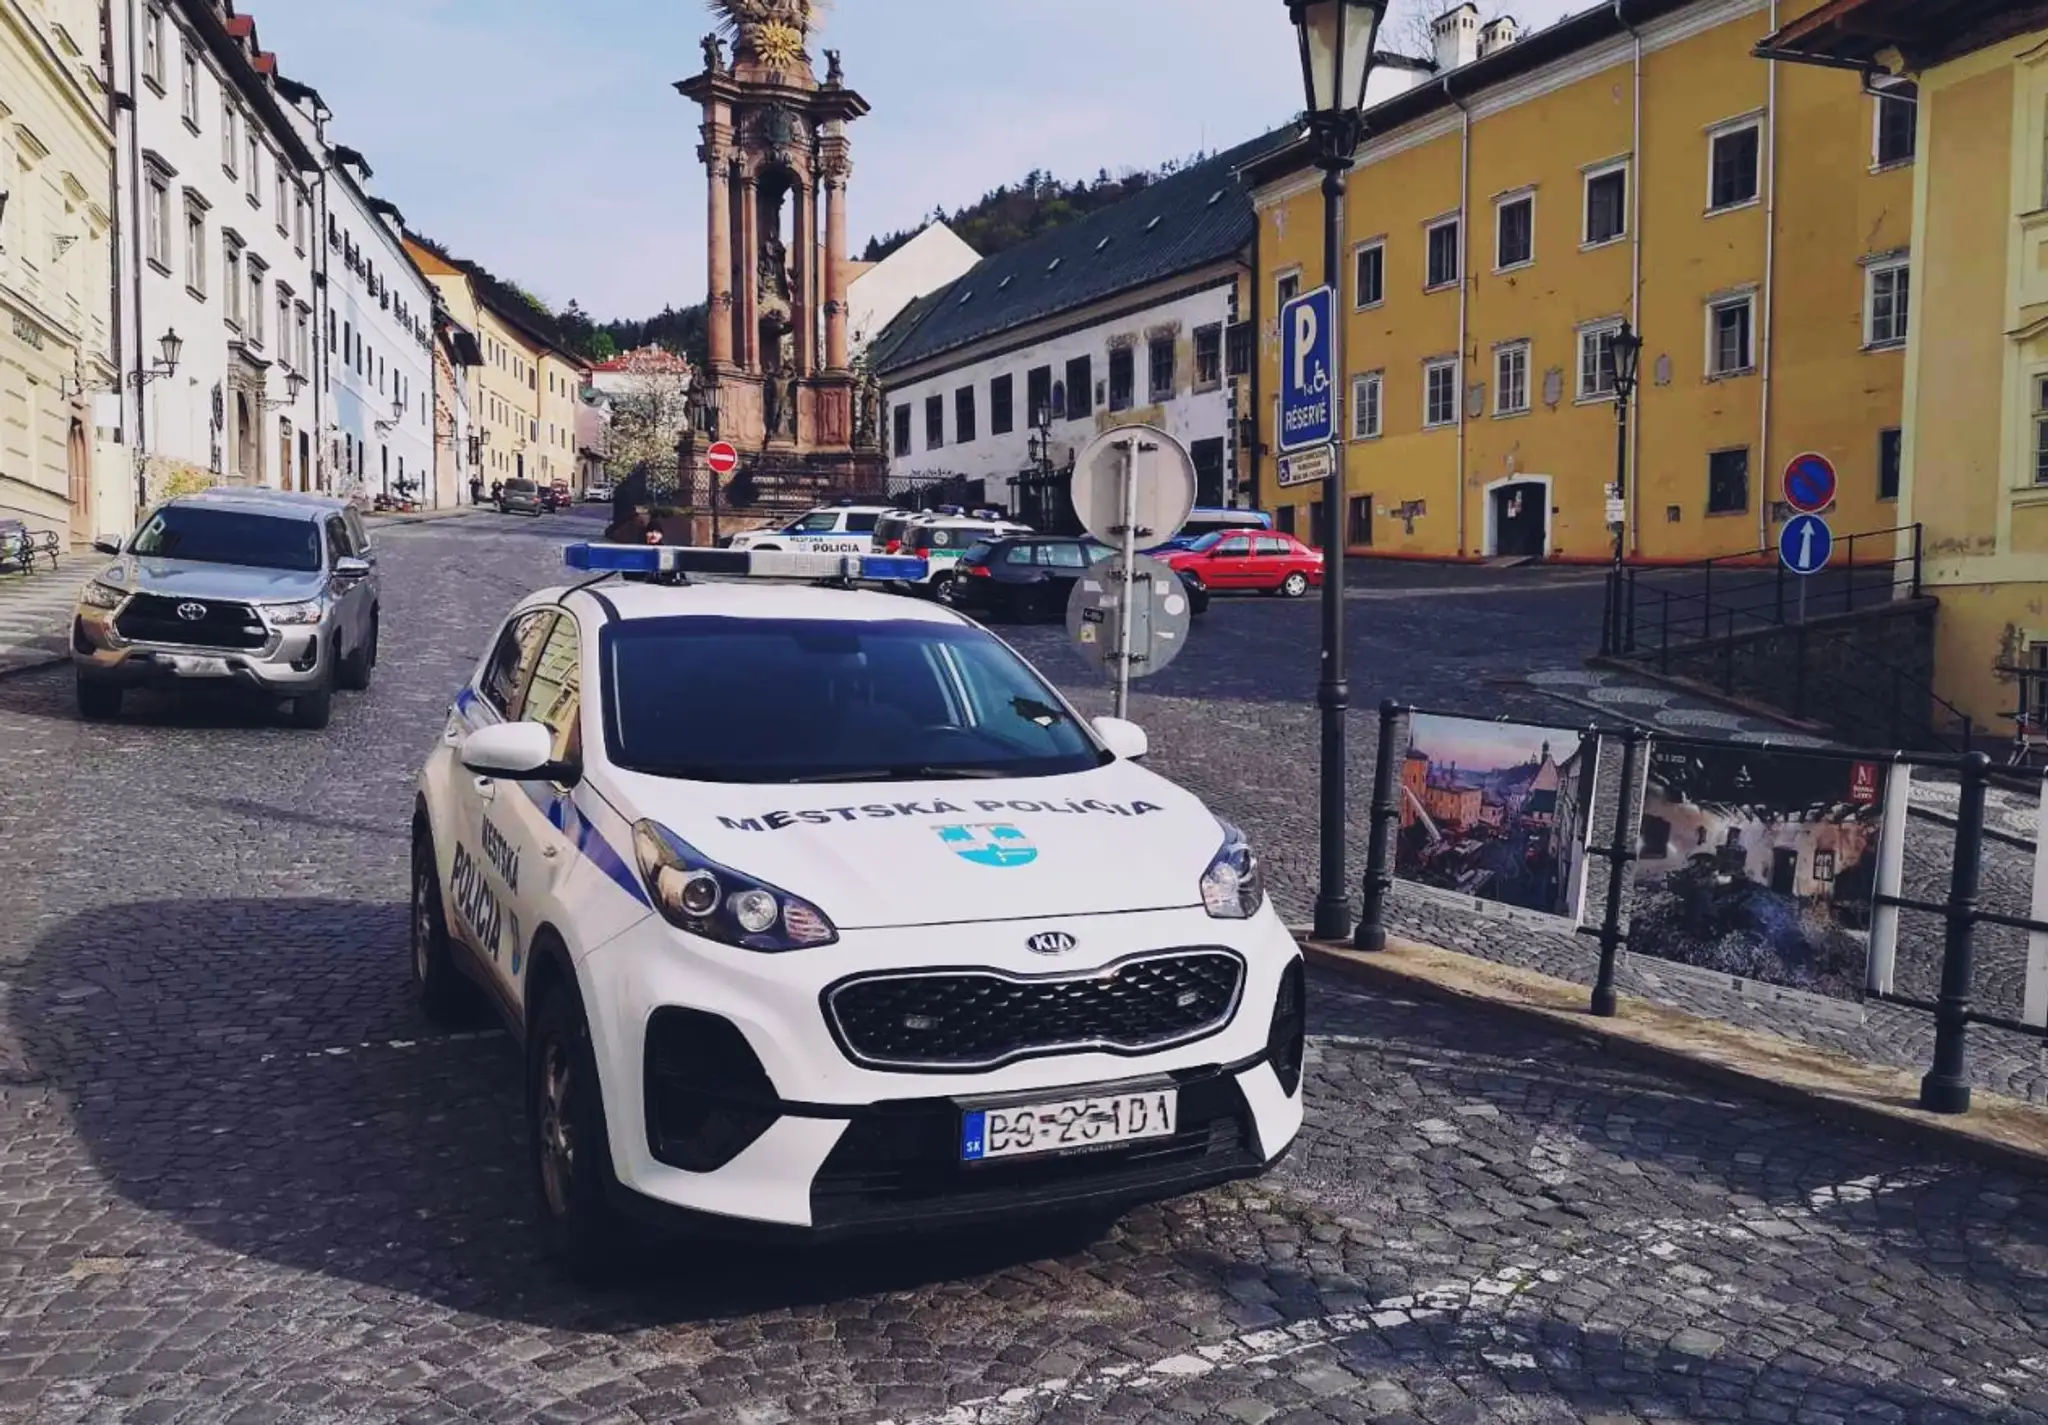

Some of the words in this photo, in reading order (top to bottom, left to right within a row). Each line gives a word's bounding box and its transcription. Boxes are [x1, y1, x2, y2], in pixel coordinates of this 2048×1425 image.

[1294, 304, 1318, 389] P
[715, 797, 963, 832] MESTSKÁ
[450, 839, 501, 963] POLÍCIA
[1033, 934, 1076, 952] KIA
[966, 1141, 982, 1153] SK
